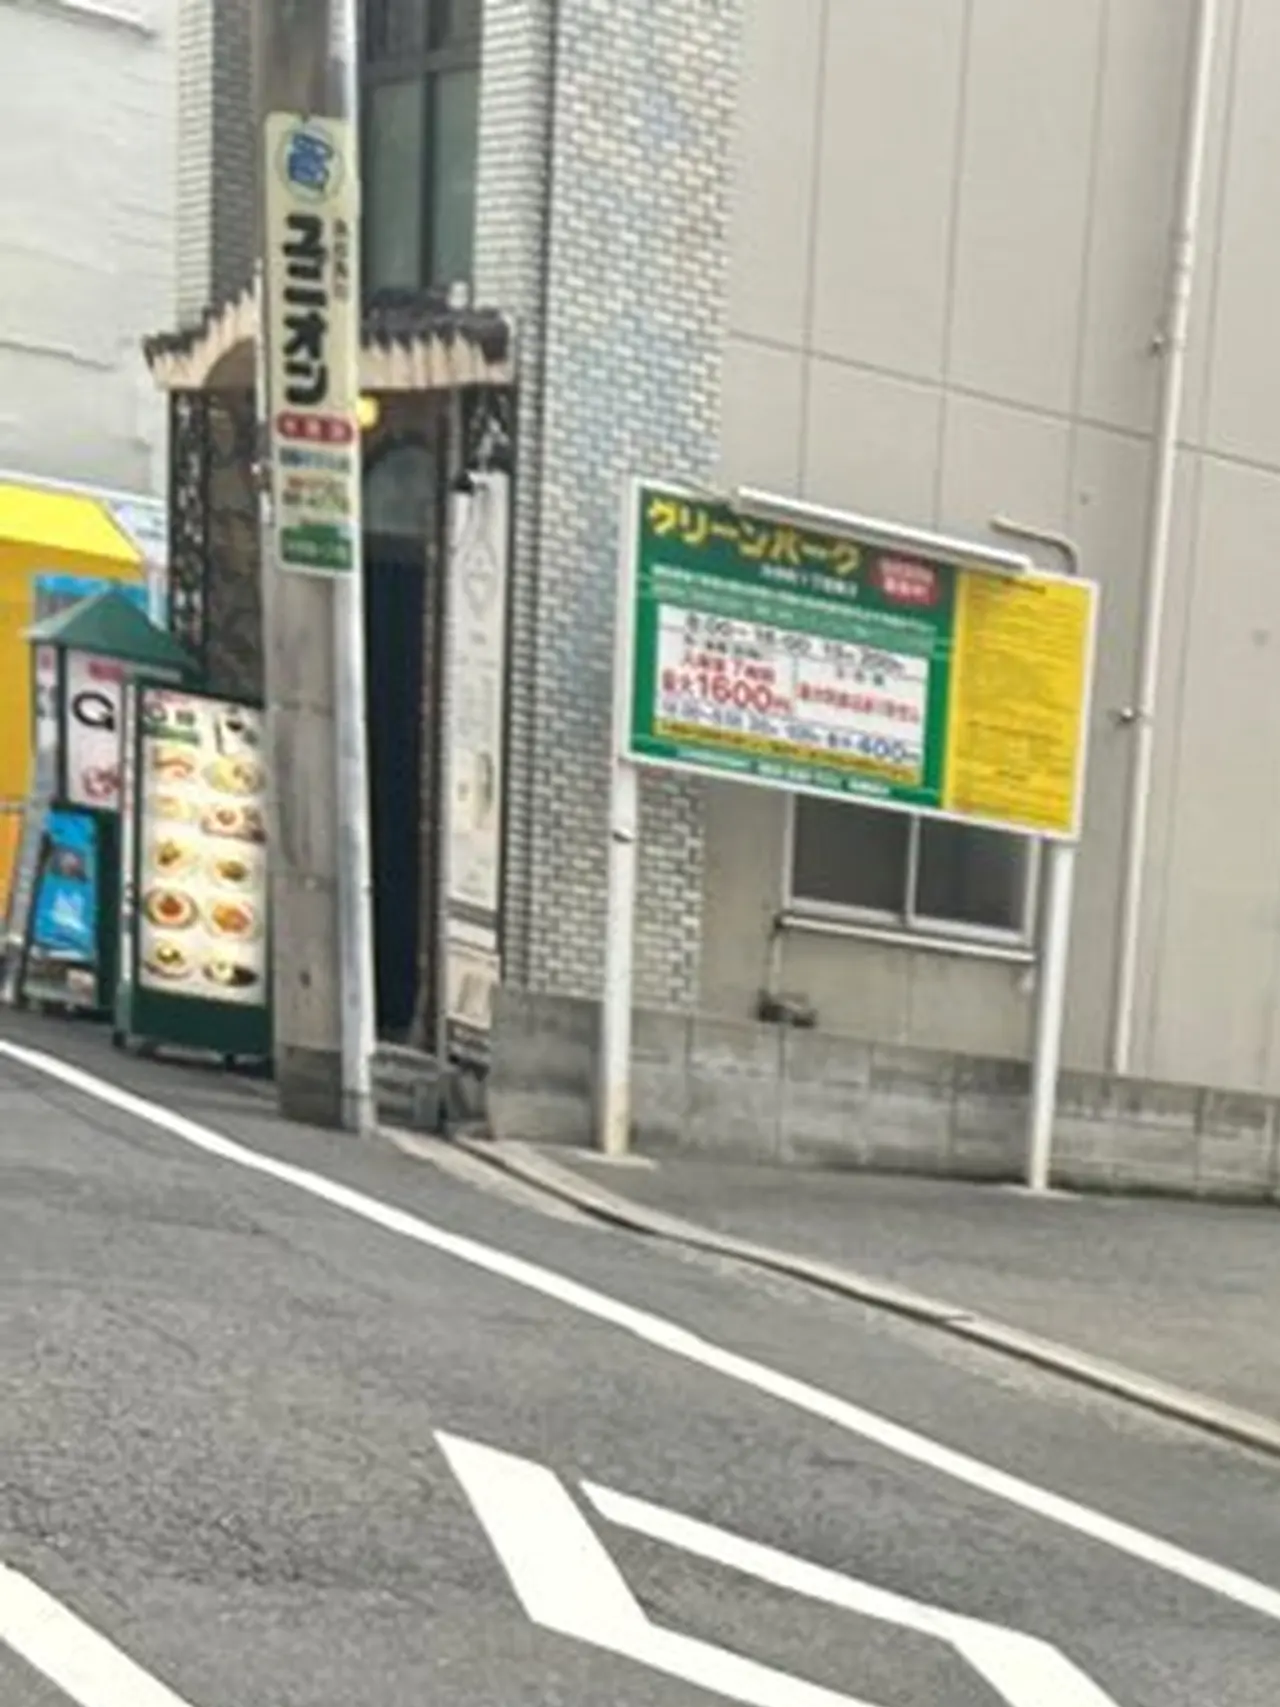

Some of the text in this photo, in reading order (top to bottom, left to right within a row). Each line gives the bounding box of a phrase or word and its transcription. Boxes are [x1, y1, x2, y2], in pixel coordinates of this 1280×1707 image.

[647, 497, 861, 575] グリーンパーク
